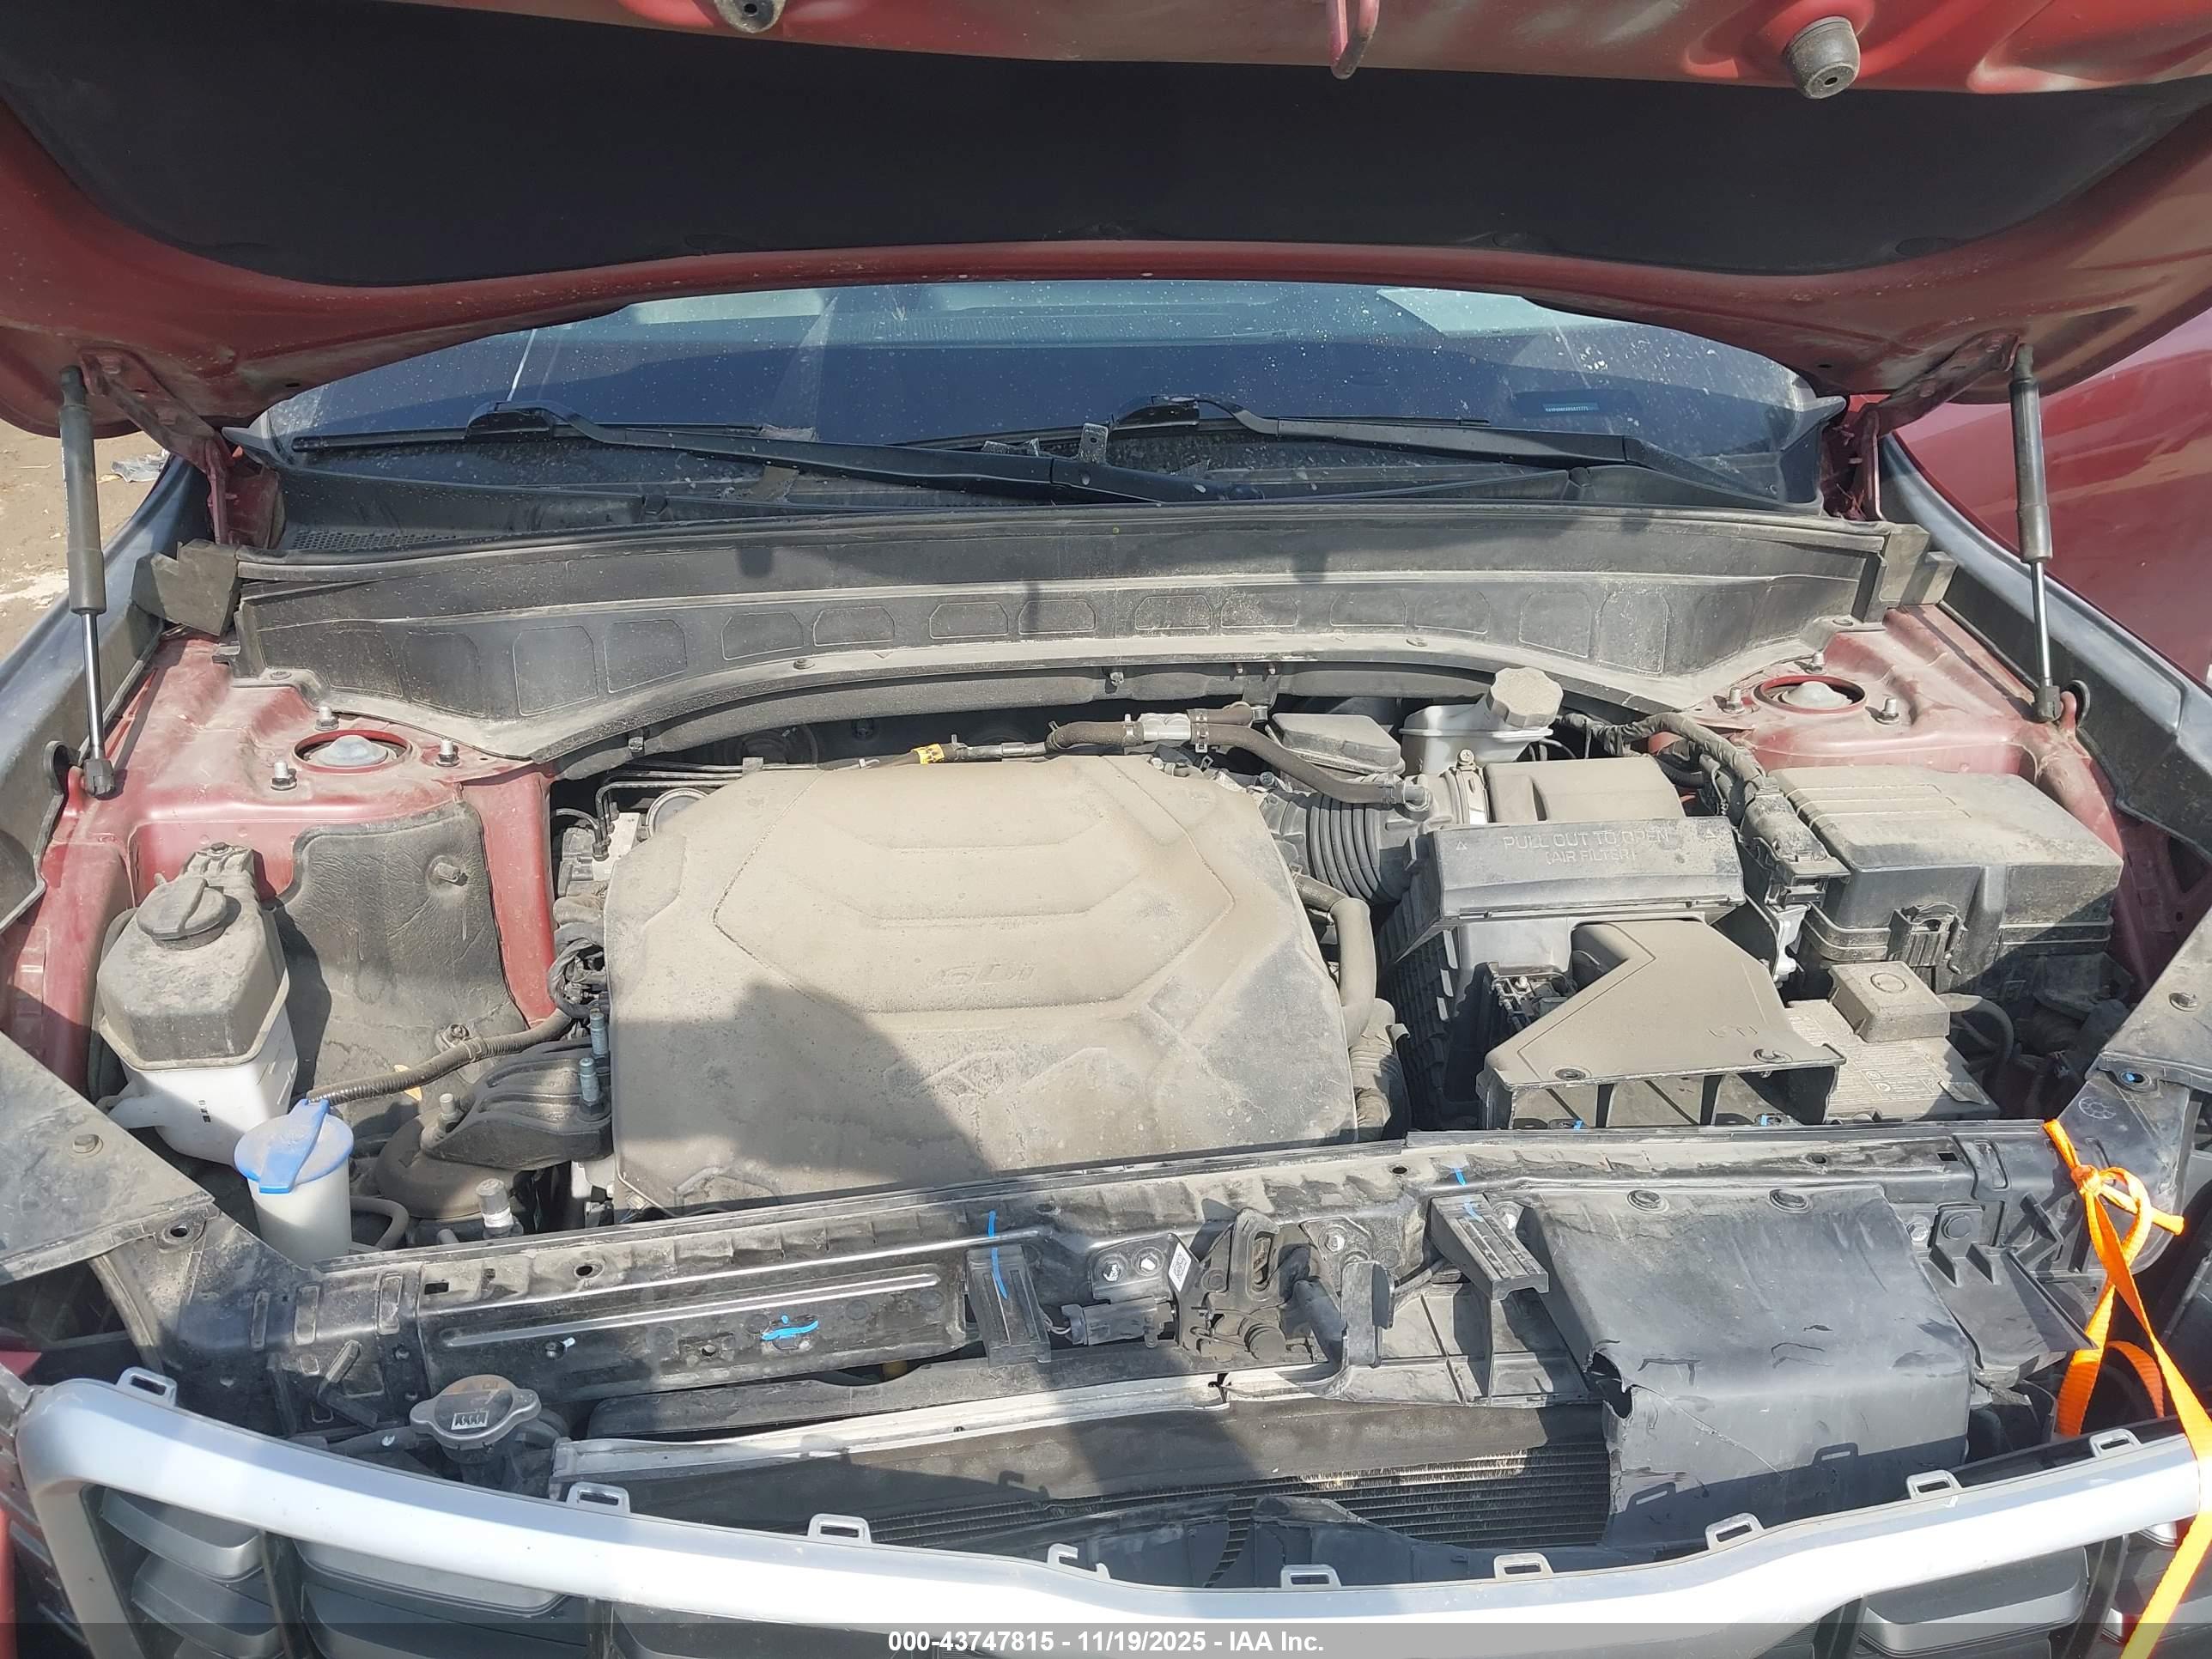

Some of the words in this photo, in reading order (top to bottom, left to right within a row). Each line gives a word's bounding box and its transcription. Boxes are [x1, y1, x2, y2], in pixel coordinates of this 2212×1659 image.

[1503, 835, 1549, 849] PULL
[1553, 831, 1589, 847] OUT
[1592, 830, 1616, 845] TO
[1620, 829, 1669, 844] OPEN
[1546, 850, 1577, 865] (AIR
